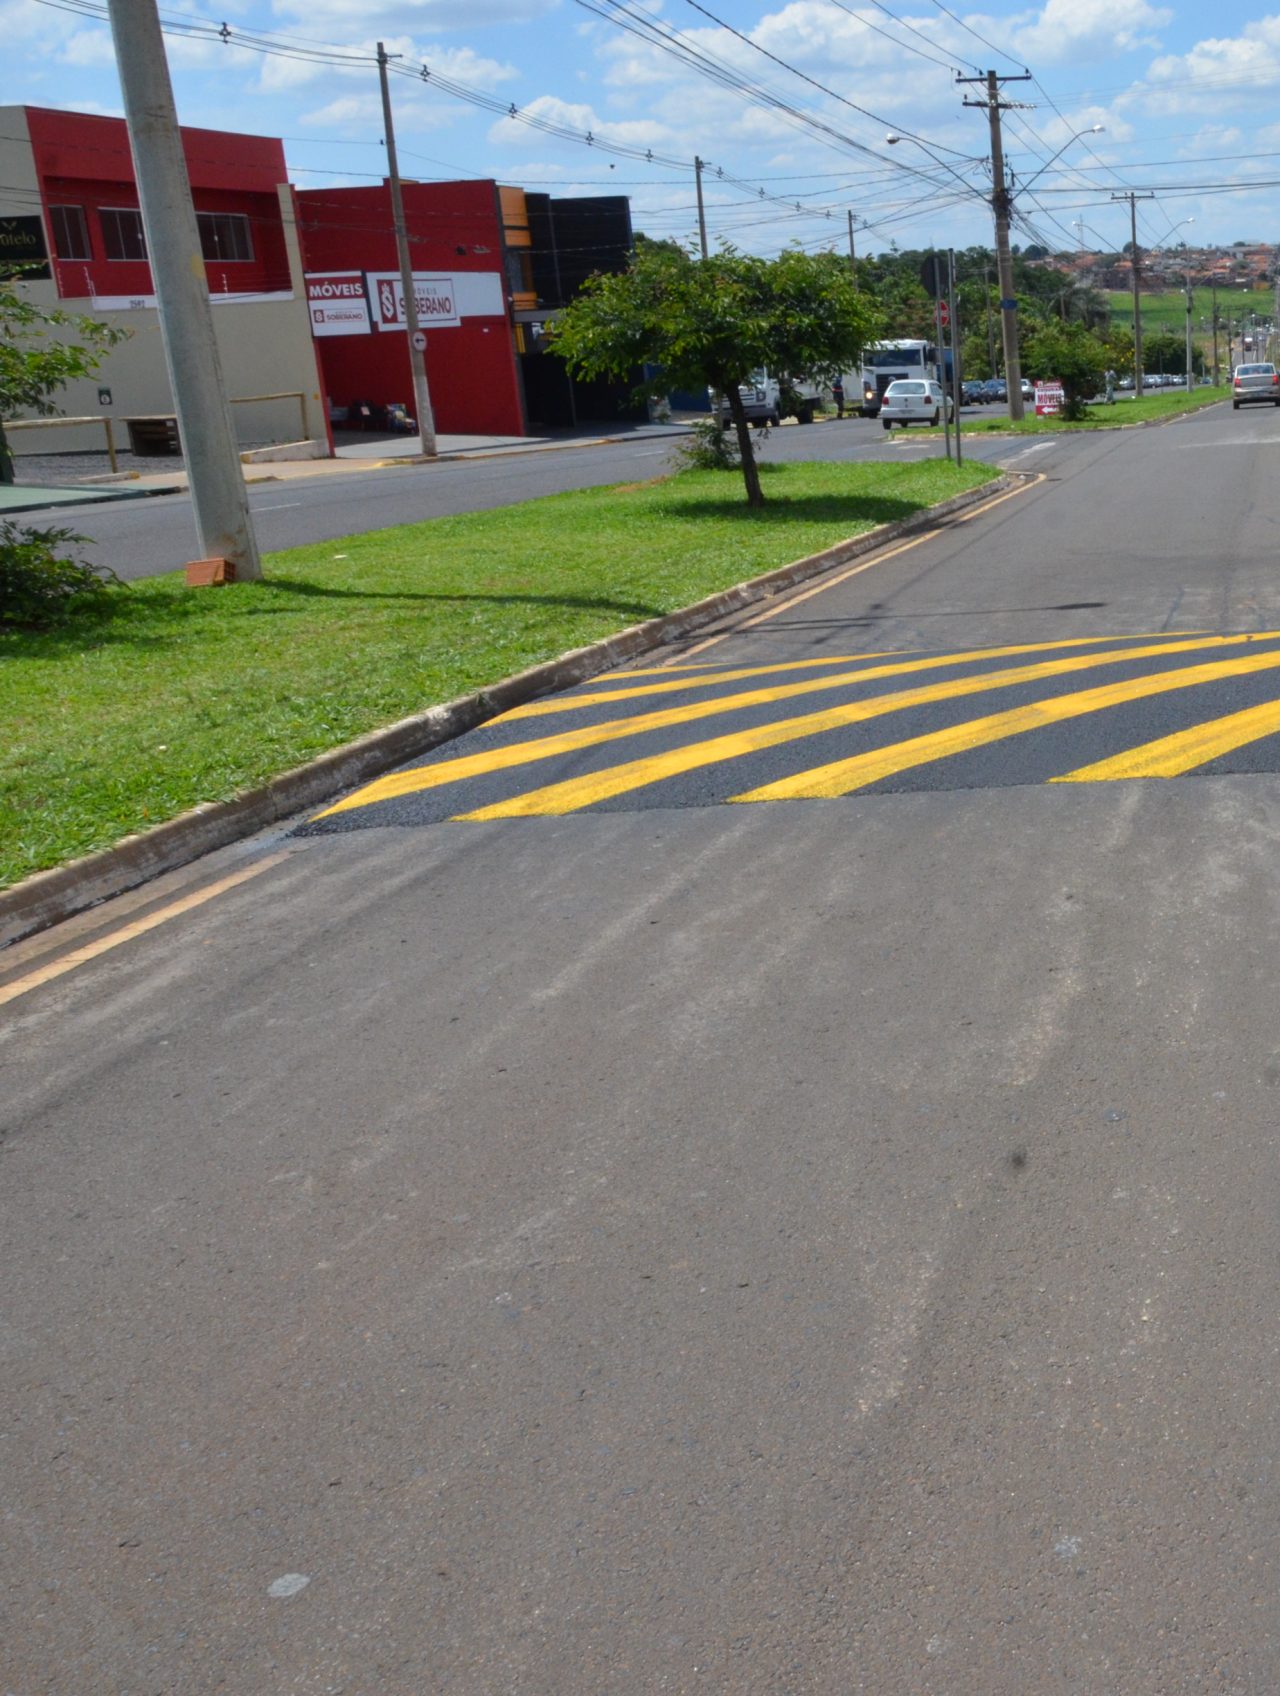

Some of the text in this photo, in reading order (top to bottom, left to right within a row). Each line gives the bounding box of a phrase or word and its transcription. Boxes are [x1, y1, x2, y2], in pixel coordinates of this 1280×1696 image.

[310, 281, 363, 297] MÓVEIS
[399, 297, 452, 315] SBERANO
[326, 313, 363, 321] SOBERANO
